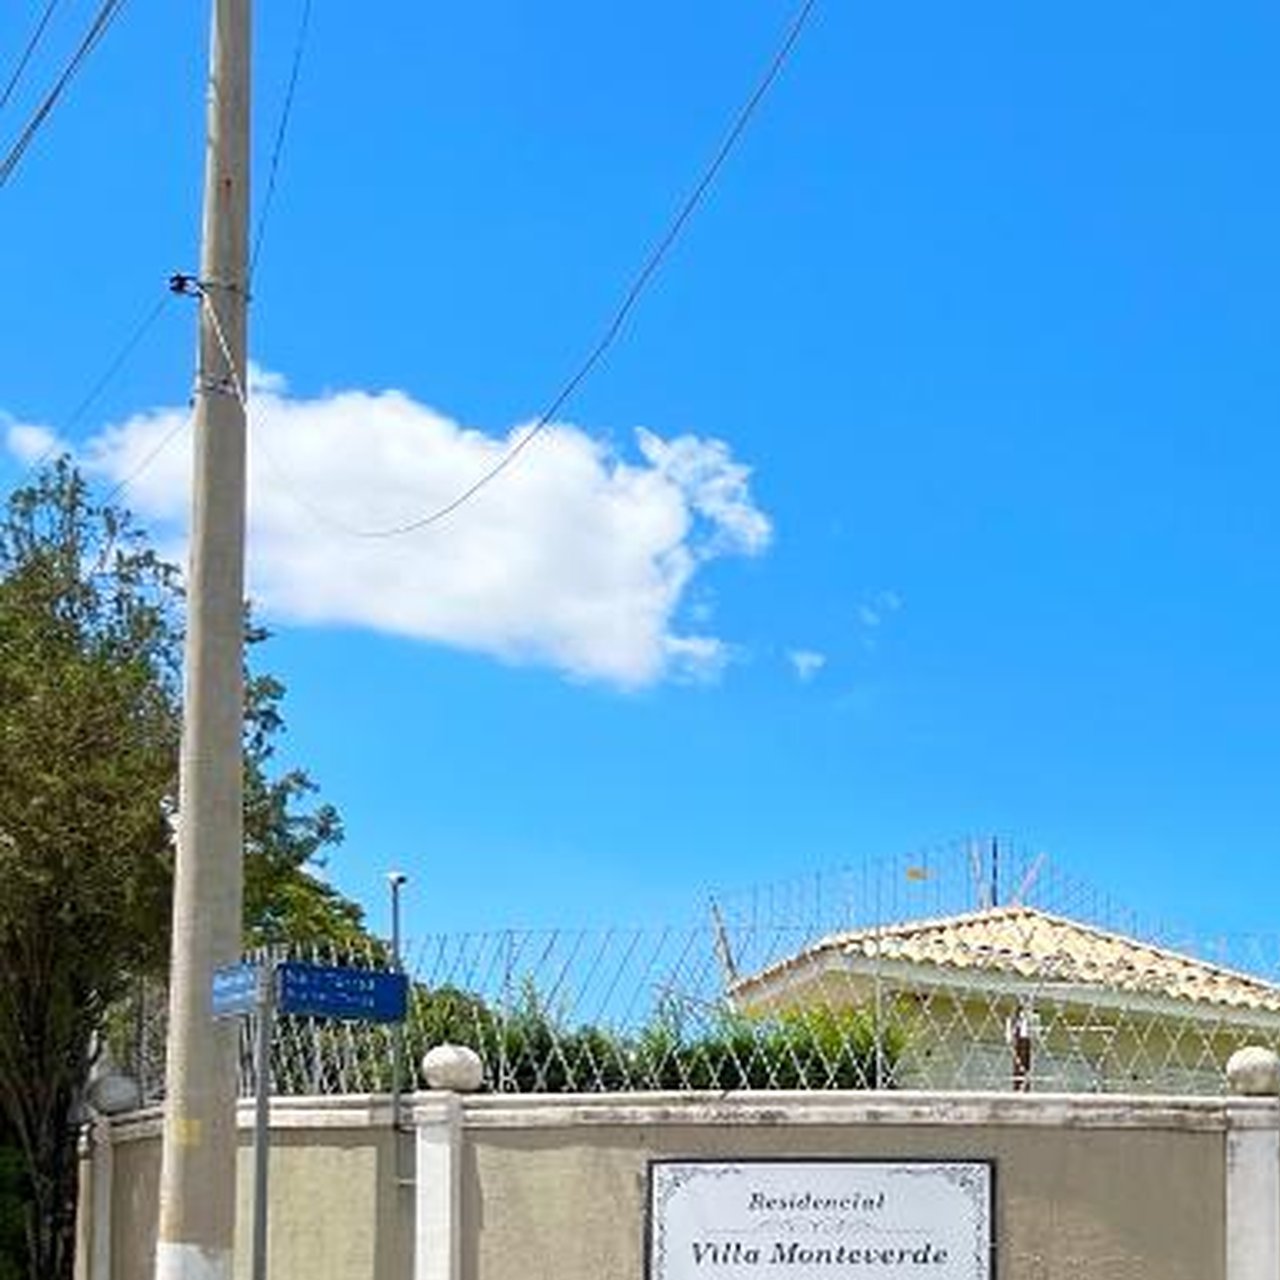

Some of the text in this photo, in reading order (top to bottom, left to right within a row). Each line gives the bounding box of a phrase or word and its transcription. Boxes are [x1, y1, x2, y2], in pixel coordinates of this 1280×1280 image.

[749, 1192, 886, 1212] Residencial
[692, 1242, 949, 1265] Villa Monteverde
